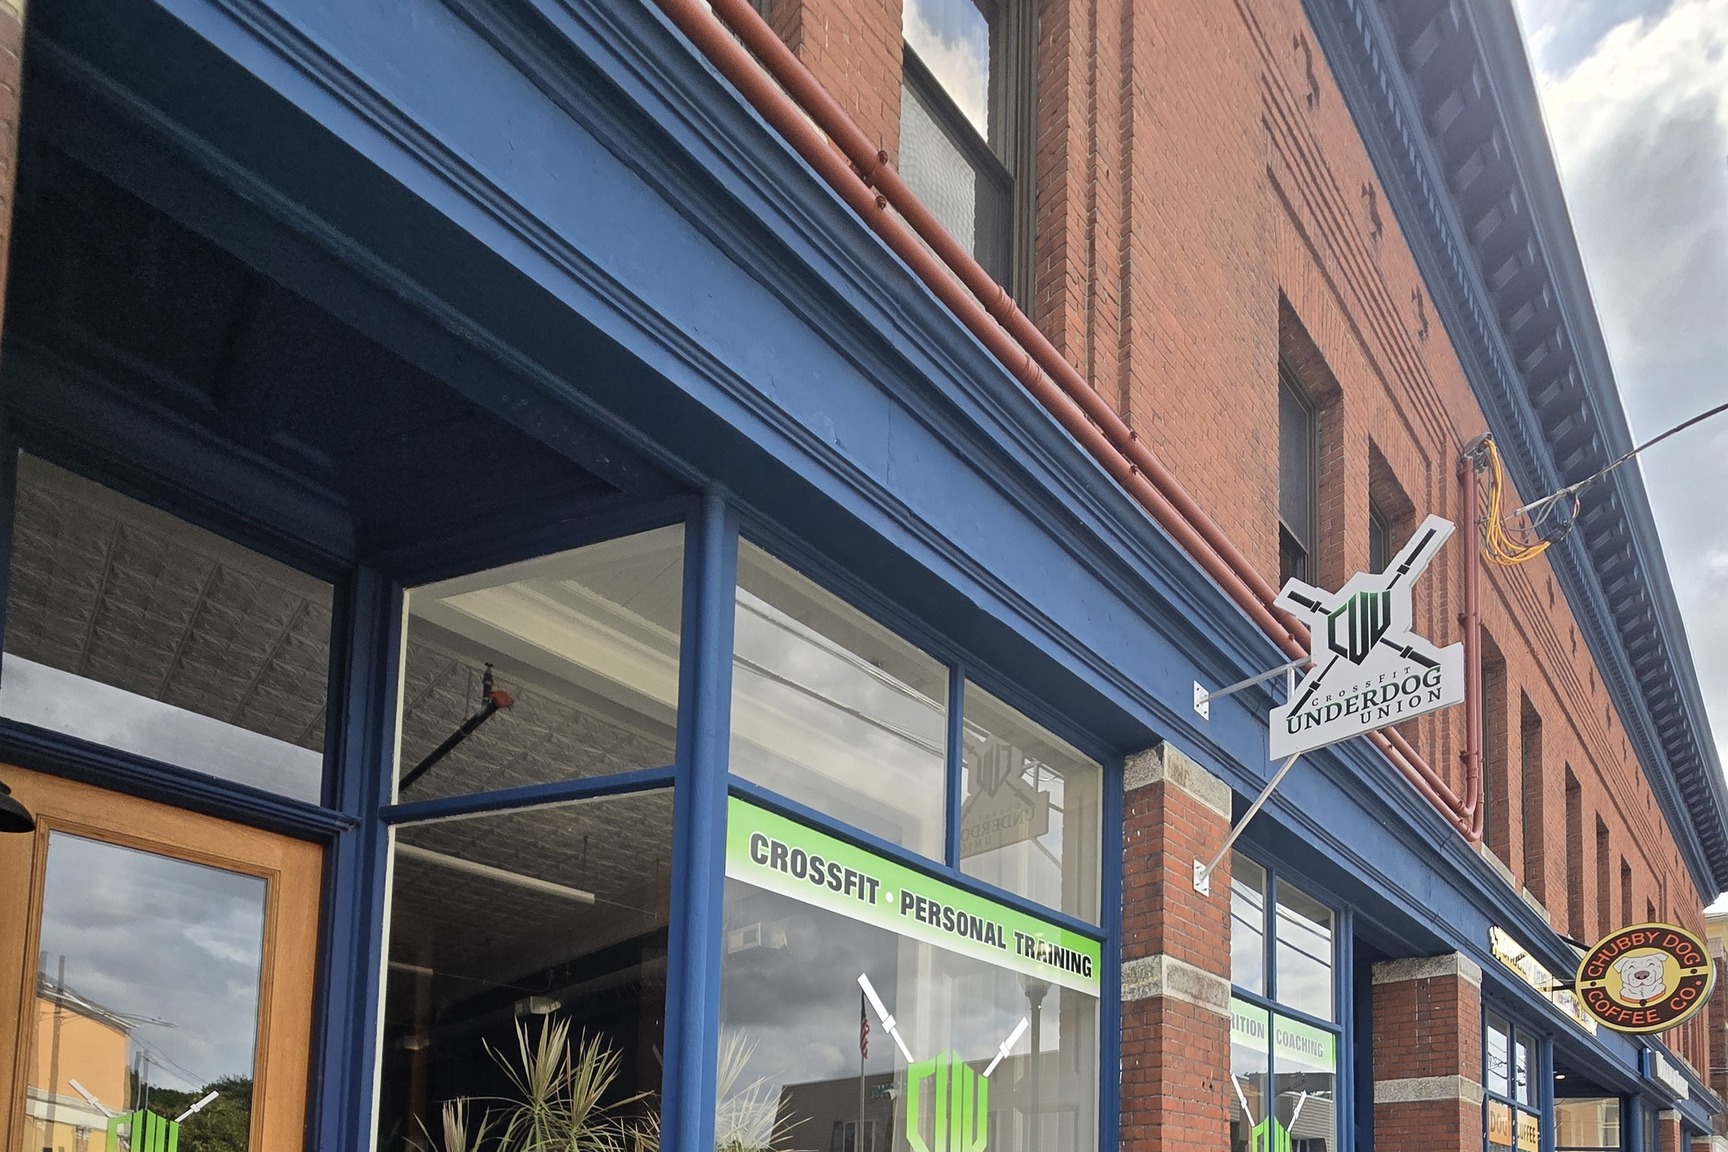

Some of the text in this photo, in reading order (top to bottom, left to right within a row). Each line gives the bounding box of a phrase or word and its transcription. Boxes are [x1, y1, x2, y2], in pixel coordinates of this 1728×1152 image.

[1286, 665, 1442, 735] UNDERDOG
[1360, 687, 1442, 725] UNION
[749, 832, 1093, 979] CROSSFIT PERSONAL TRAINING
[1587, 931, 1660, 977] CHUBBY
[1663, 933, 1701, 965] DOG
[1587, 990, 1661, 1024] COFFEE
[1670, 980, 1702, 1011] CO.
[1231, 1012, 1323, 1058] RITION COACHING
